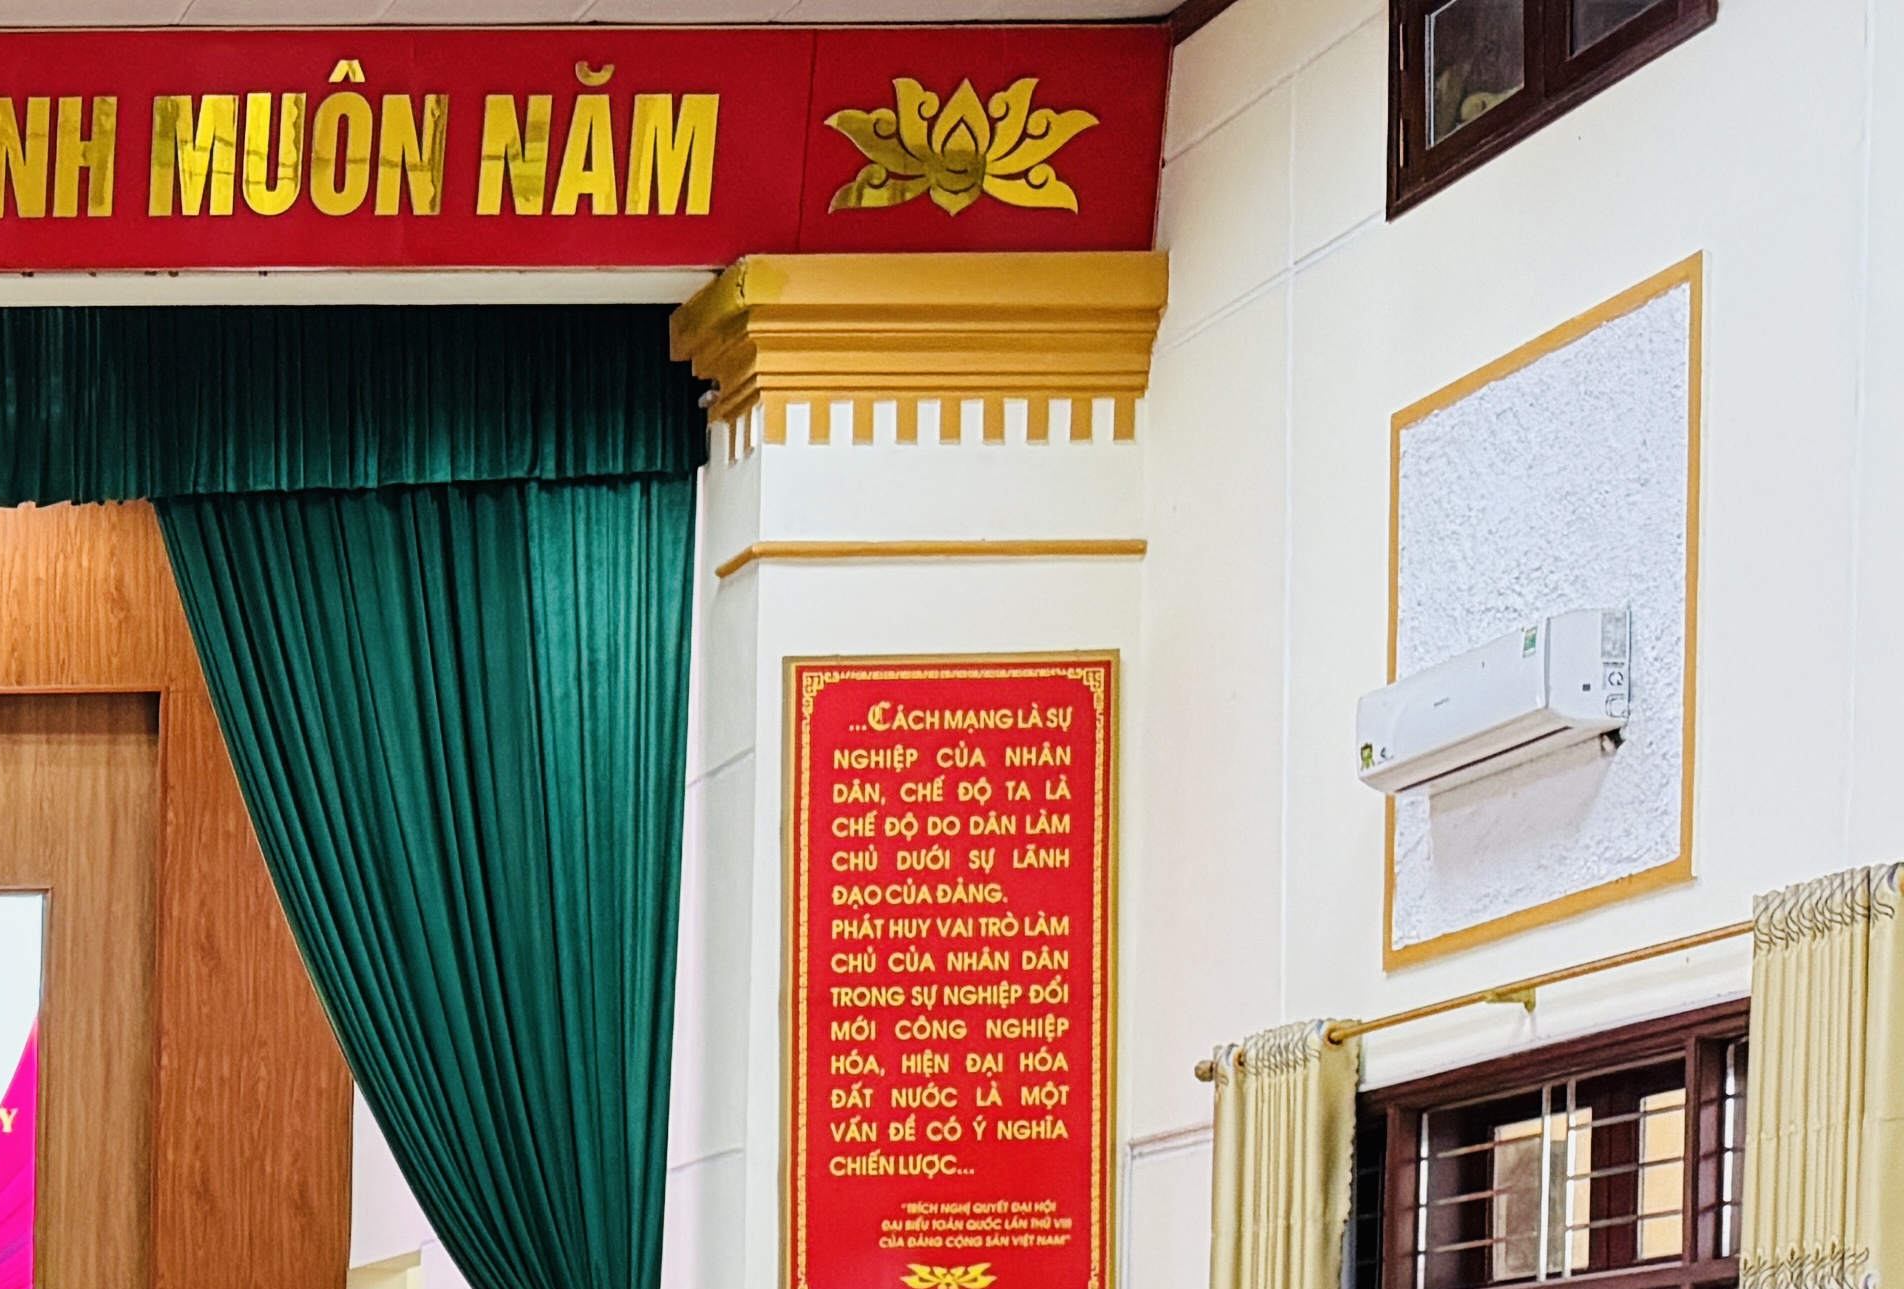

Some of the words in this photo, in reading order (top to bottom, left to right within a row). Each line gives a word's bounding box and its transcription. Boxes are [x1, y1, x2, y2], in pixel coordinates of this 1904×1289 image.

[147, 60, 446, 218] MUÔN
[477, 62, 718, 217] NĂM
[944, 709, 1014, 733] MẠNG
[1018, 703, 1042, 728] LÀ
[1046, 707, 1072, 731] SỰ
[834, 744, 918, 772] NGHIỆP
[937, 741, 985, 768] CỦA
[1006, 742, 1071, 766] NHÂN
[833, 779, 885, 805] DÂN,
[900, 775, 945, 802] CHẾ
[958, 777, 992, 805] ĐỘ
[1006, 781, 1031, 800] TA
[1046, 775, 1071, 800] LÀ
[832, 810, 877, 837] CHẾ
[884, 812, 918, 841] ĐỘ
[928, 816, 960, 836] DO
[970, 811, 1016, 835] DÂN
[1026, 809, 1070, 834] LÀM
[832, 844, 878, 871] CHỦ
[897, 844, 950, 870] DƯỚI
[969, 848, 995, 873] SỰ
[1013, 844, 1069, 868] LÃNH
[832, 885, 882, 909] ĐẠO
[885, 878, 932, 904] CỦA
[936, 877, 1007, 903] ĐẢNG.
[832, 913, 884, 939] PHÁT
[889, 919, 931, 938] HUY
[936, 918, 973, 937] VAI
[979, 912, 1019, 937] TRÒ
[1025, 911, 1069, 936] LÀM
[831, 946, 876, 973] CHỦ
[888, 945, 935, 972] CỦA
[947, 947, 1009, 971] NHÂN
[1022, 946, 1068, 970] DÂN
[831, 1016, 875, 1041] MỚI
[895, 1015, 967, 1040] CÔNG
[986, 1013, 1069, 1042] NGHIỆP
[831, 1049, 885, 1076] HÓA,
[902, 1049, 949, 1077] HIỆN
[966, 1053, 1003, 1077] ĐẠI
[1020, 1046, 1068, 1072] HÓA
[831, 1082, 873, 1108] ĐẤT
[891, 1082, 957, 1108] NƯỚC
[976, 1081, 1002, 1106] LÀ
[1021, 1081, 1069, 1109] MỘT
[830, 1149, 894, 1176] CHIẾN
